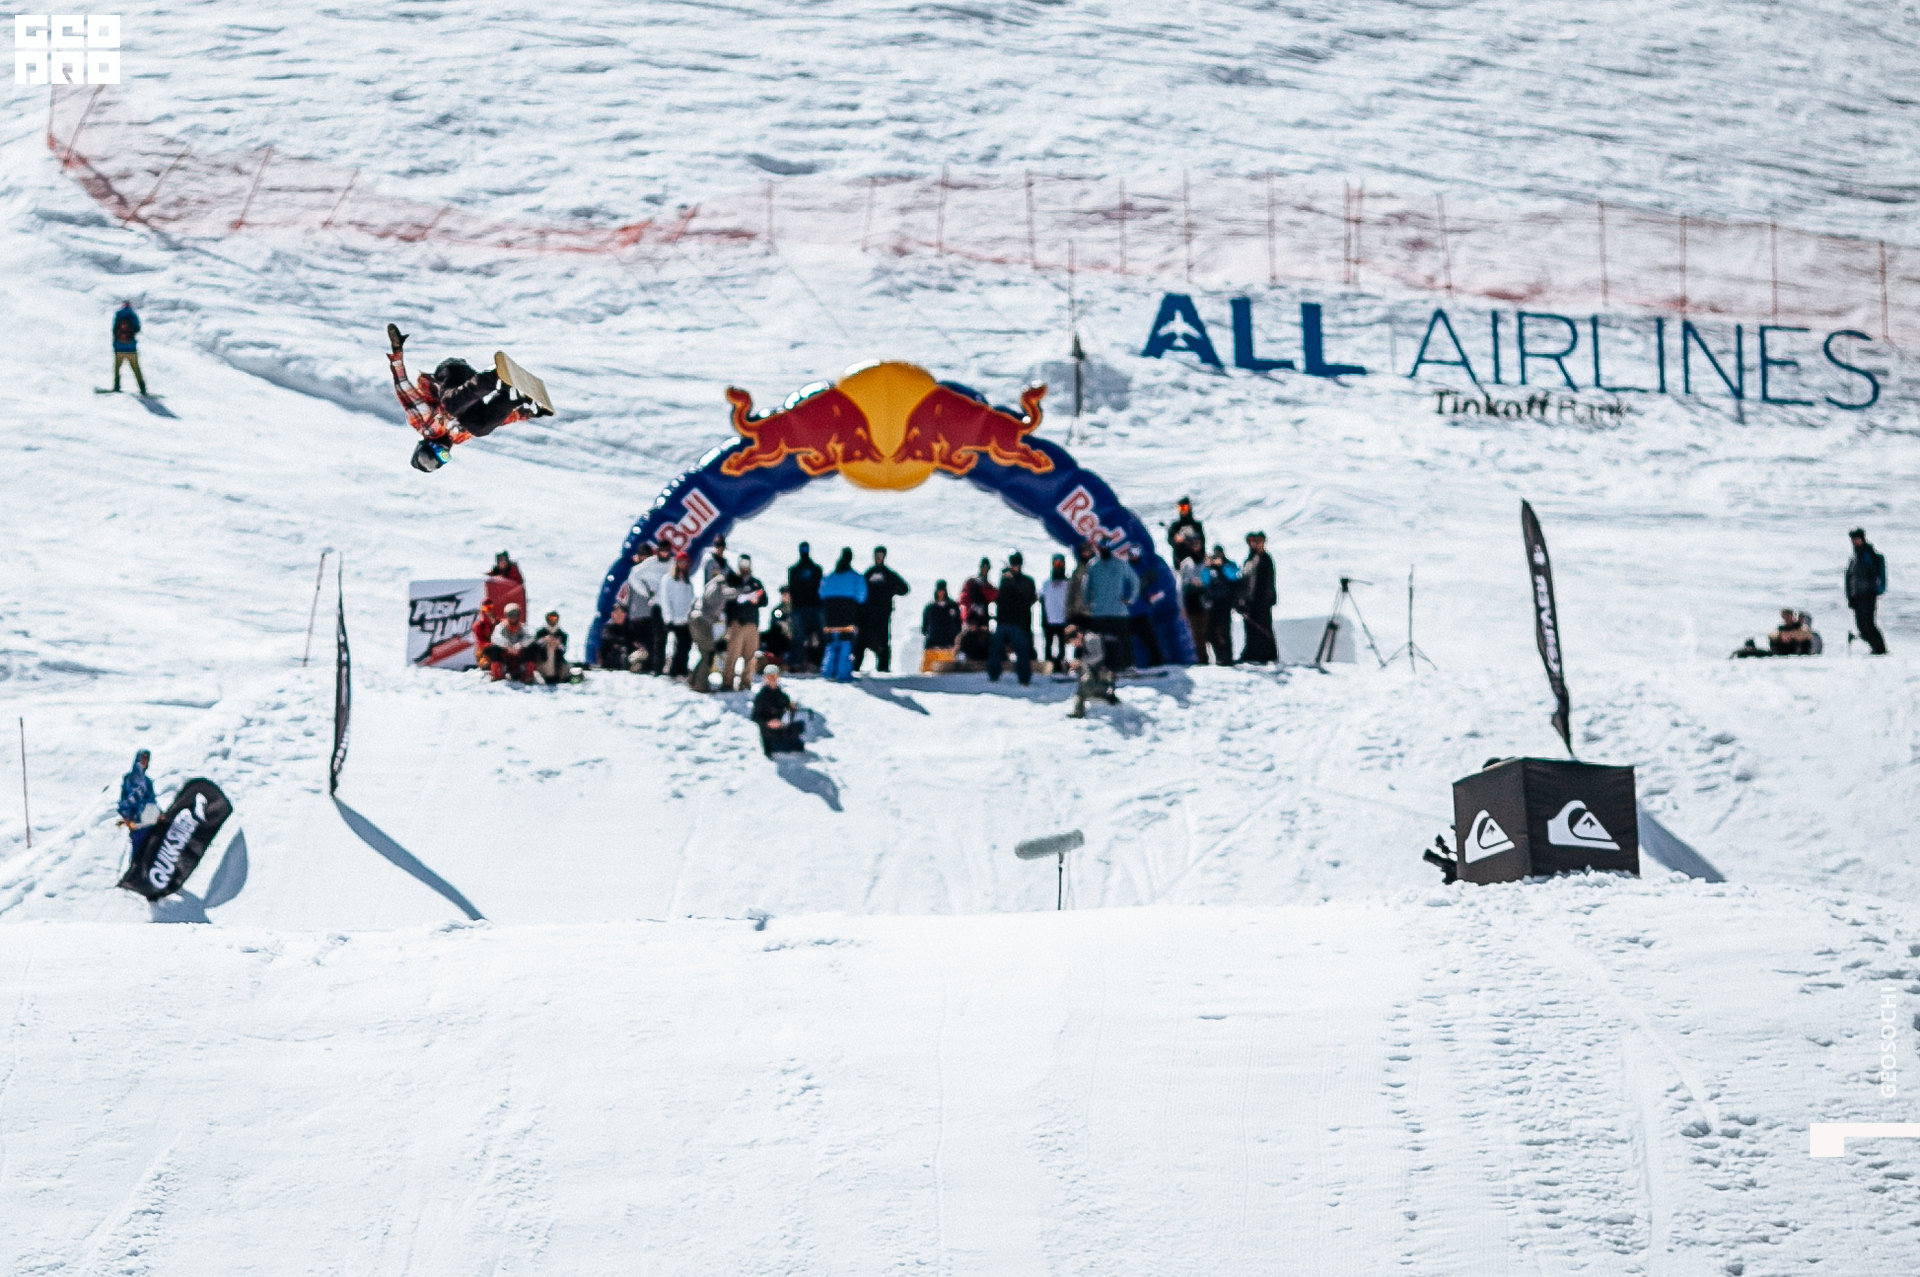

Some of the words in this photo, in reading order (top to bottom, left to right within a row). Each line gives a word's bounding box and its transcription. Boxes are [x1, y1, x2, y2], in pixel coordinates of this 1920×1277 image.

[1140, 292, 1368, 377] ALL
[1409, 308, 1880, 411] AIRLINES
[653, 487, 720, 552] Bull
